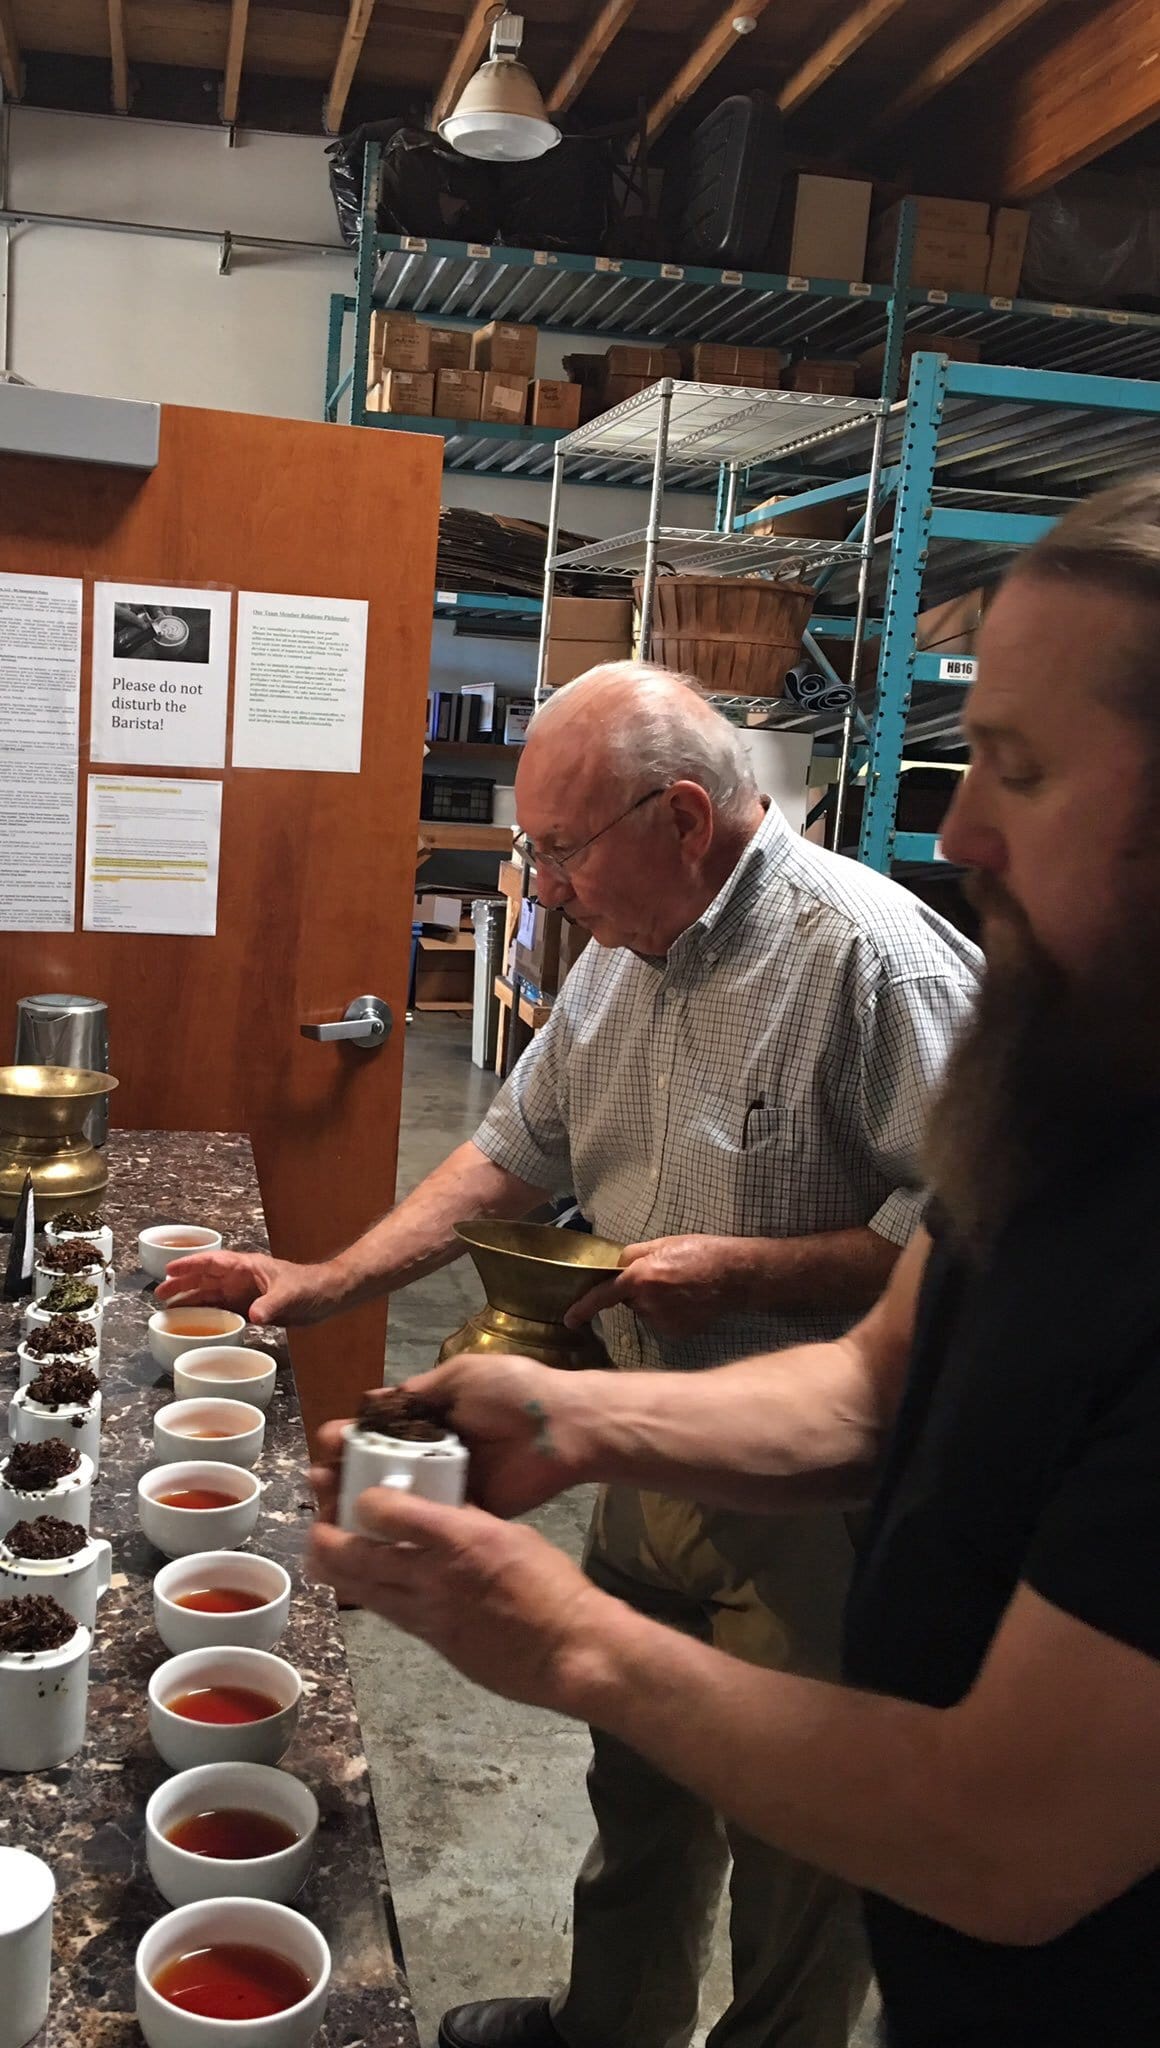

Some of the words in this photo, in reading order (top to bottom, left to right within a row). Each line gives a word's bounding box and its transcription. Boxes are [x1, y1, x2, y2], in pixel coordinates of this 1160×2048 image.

[947, 661, 973, 675] HB16
[112, 677, 156, 692] Please
[159, 680, 177, 694] do
[180, 684, 204, 695] not
[111, 696, 162, 712] disturb
[165, 700, 187, 713] the
[111, 715, 164, 731] Barista!
